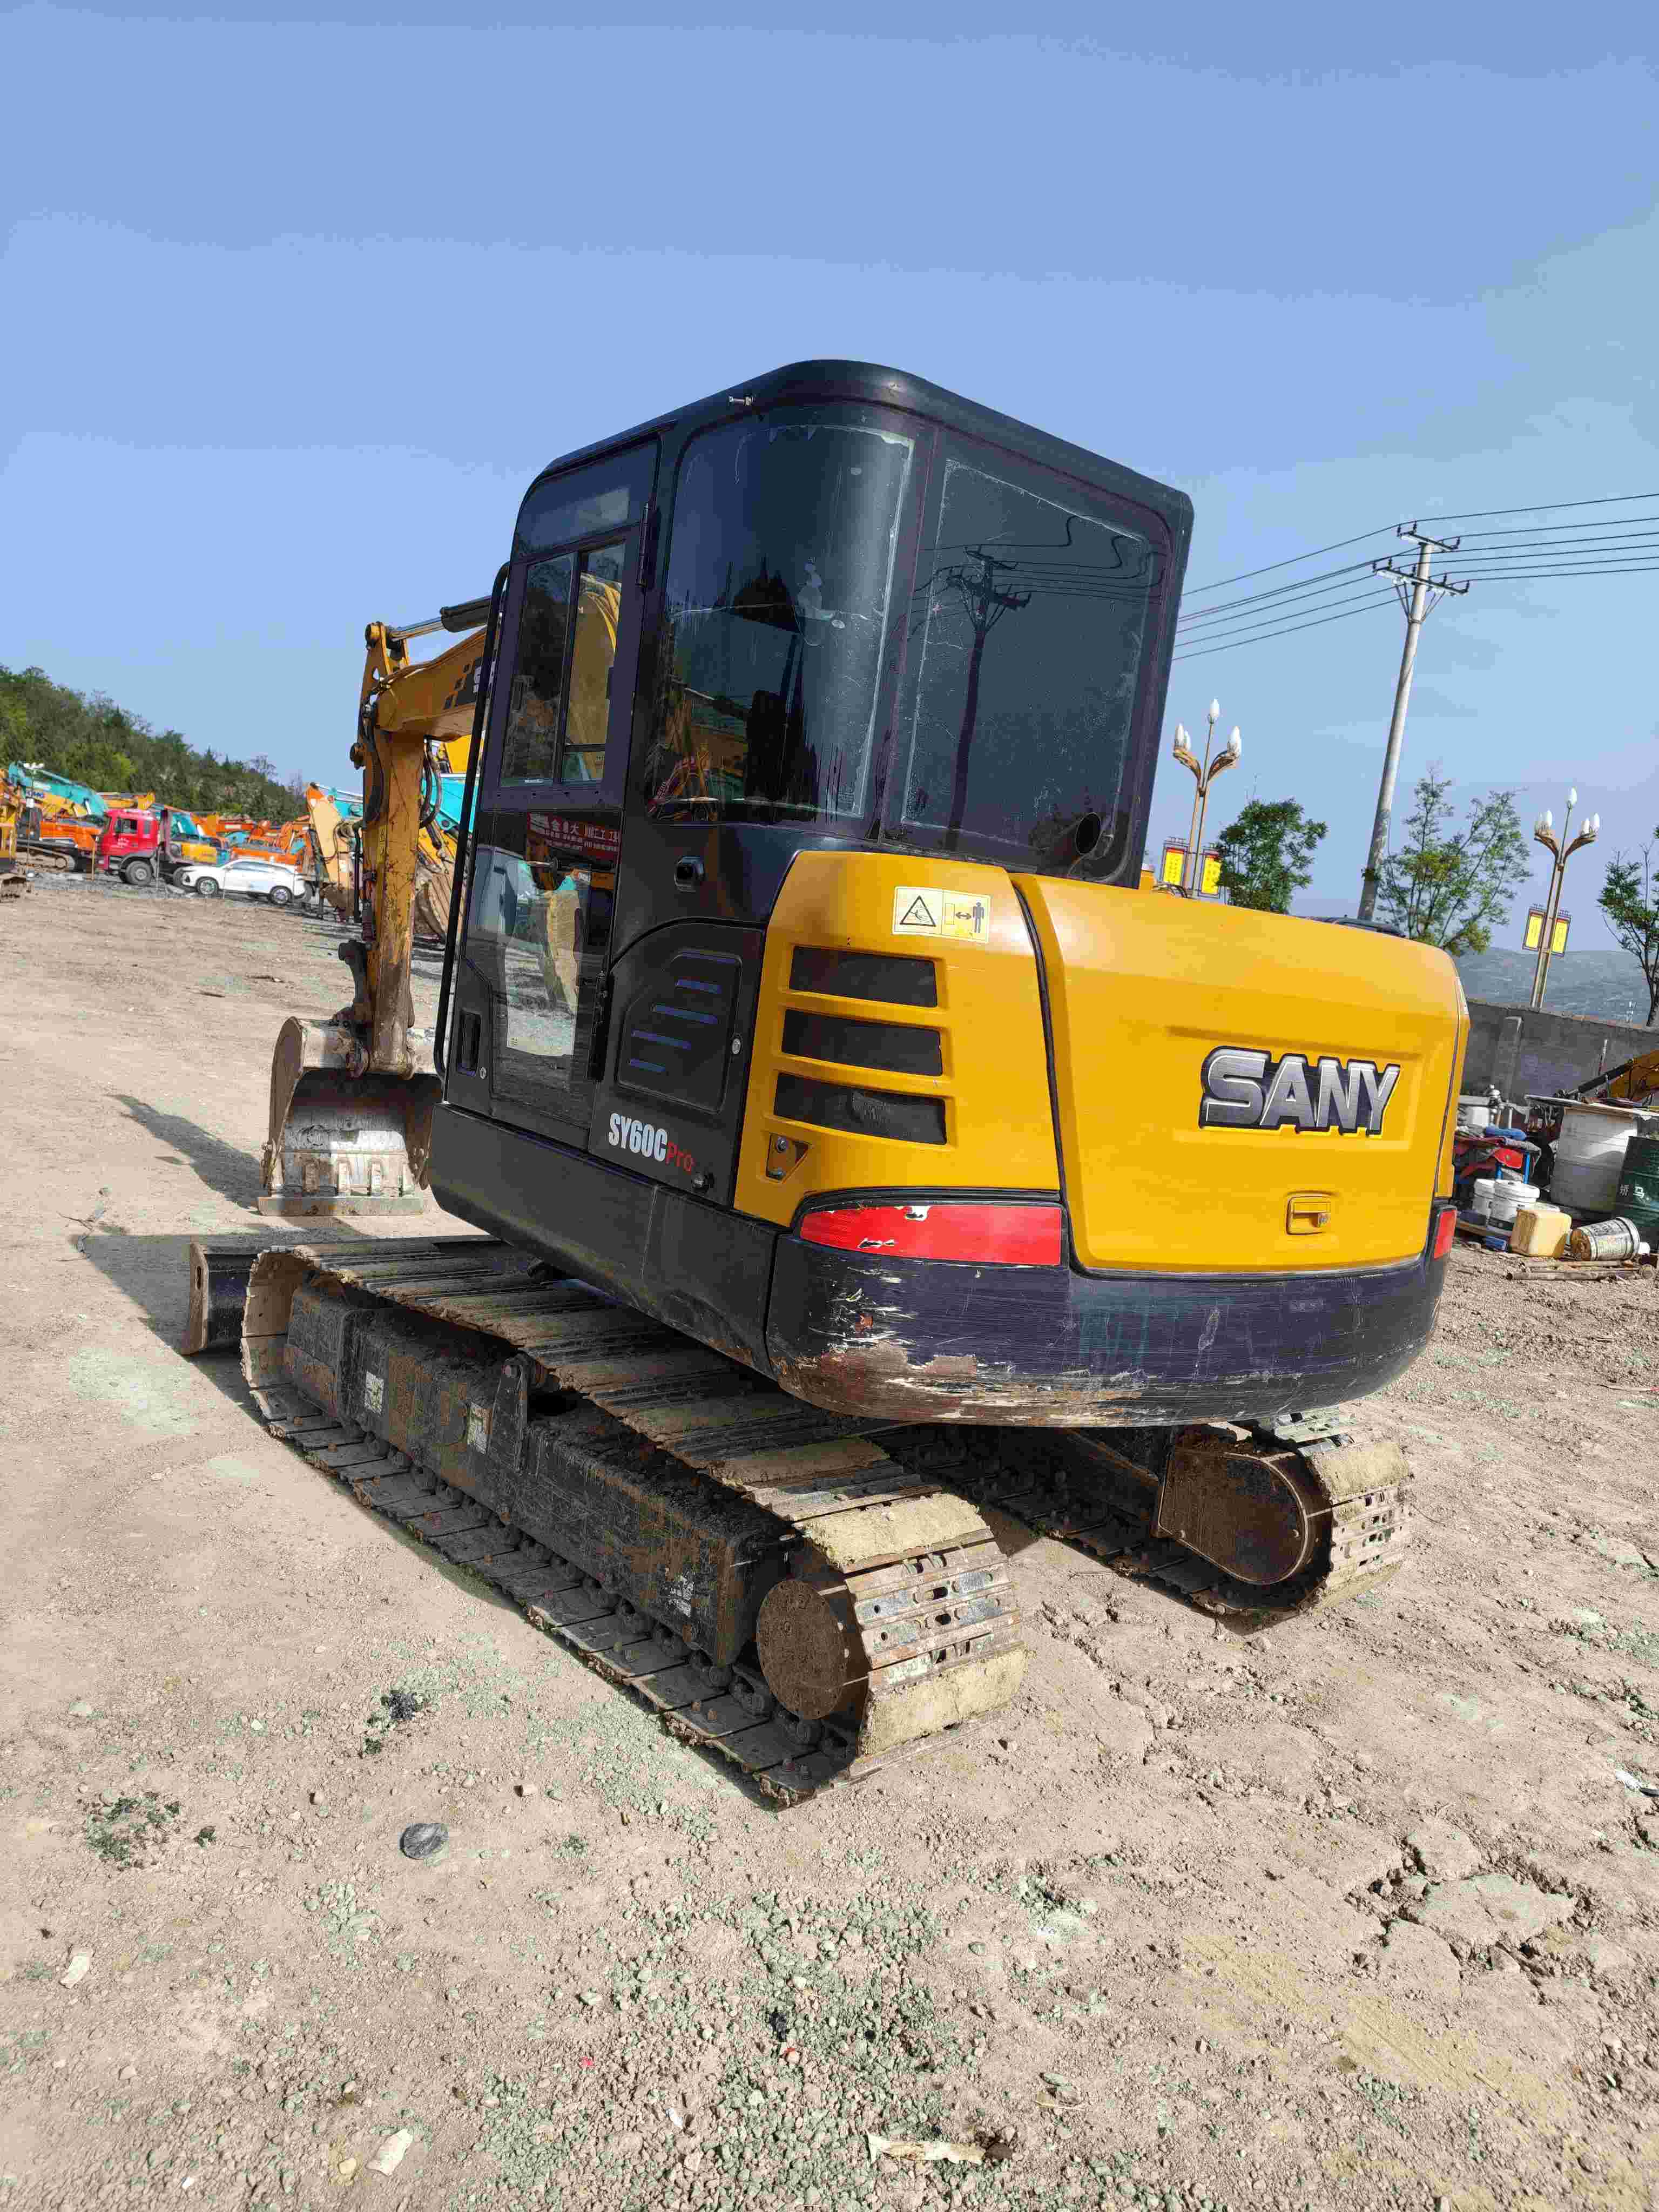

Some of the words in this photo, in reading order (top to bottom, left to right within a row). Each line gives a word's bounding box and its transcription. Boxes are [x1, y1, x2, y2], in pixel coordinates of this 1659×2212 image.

[1200, 1046, 1400, 1136] SANY
[609, 1113, 667, 1162] SY60C
[665, 1141, 696, 1171] Pro
